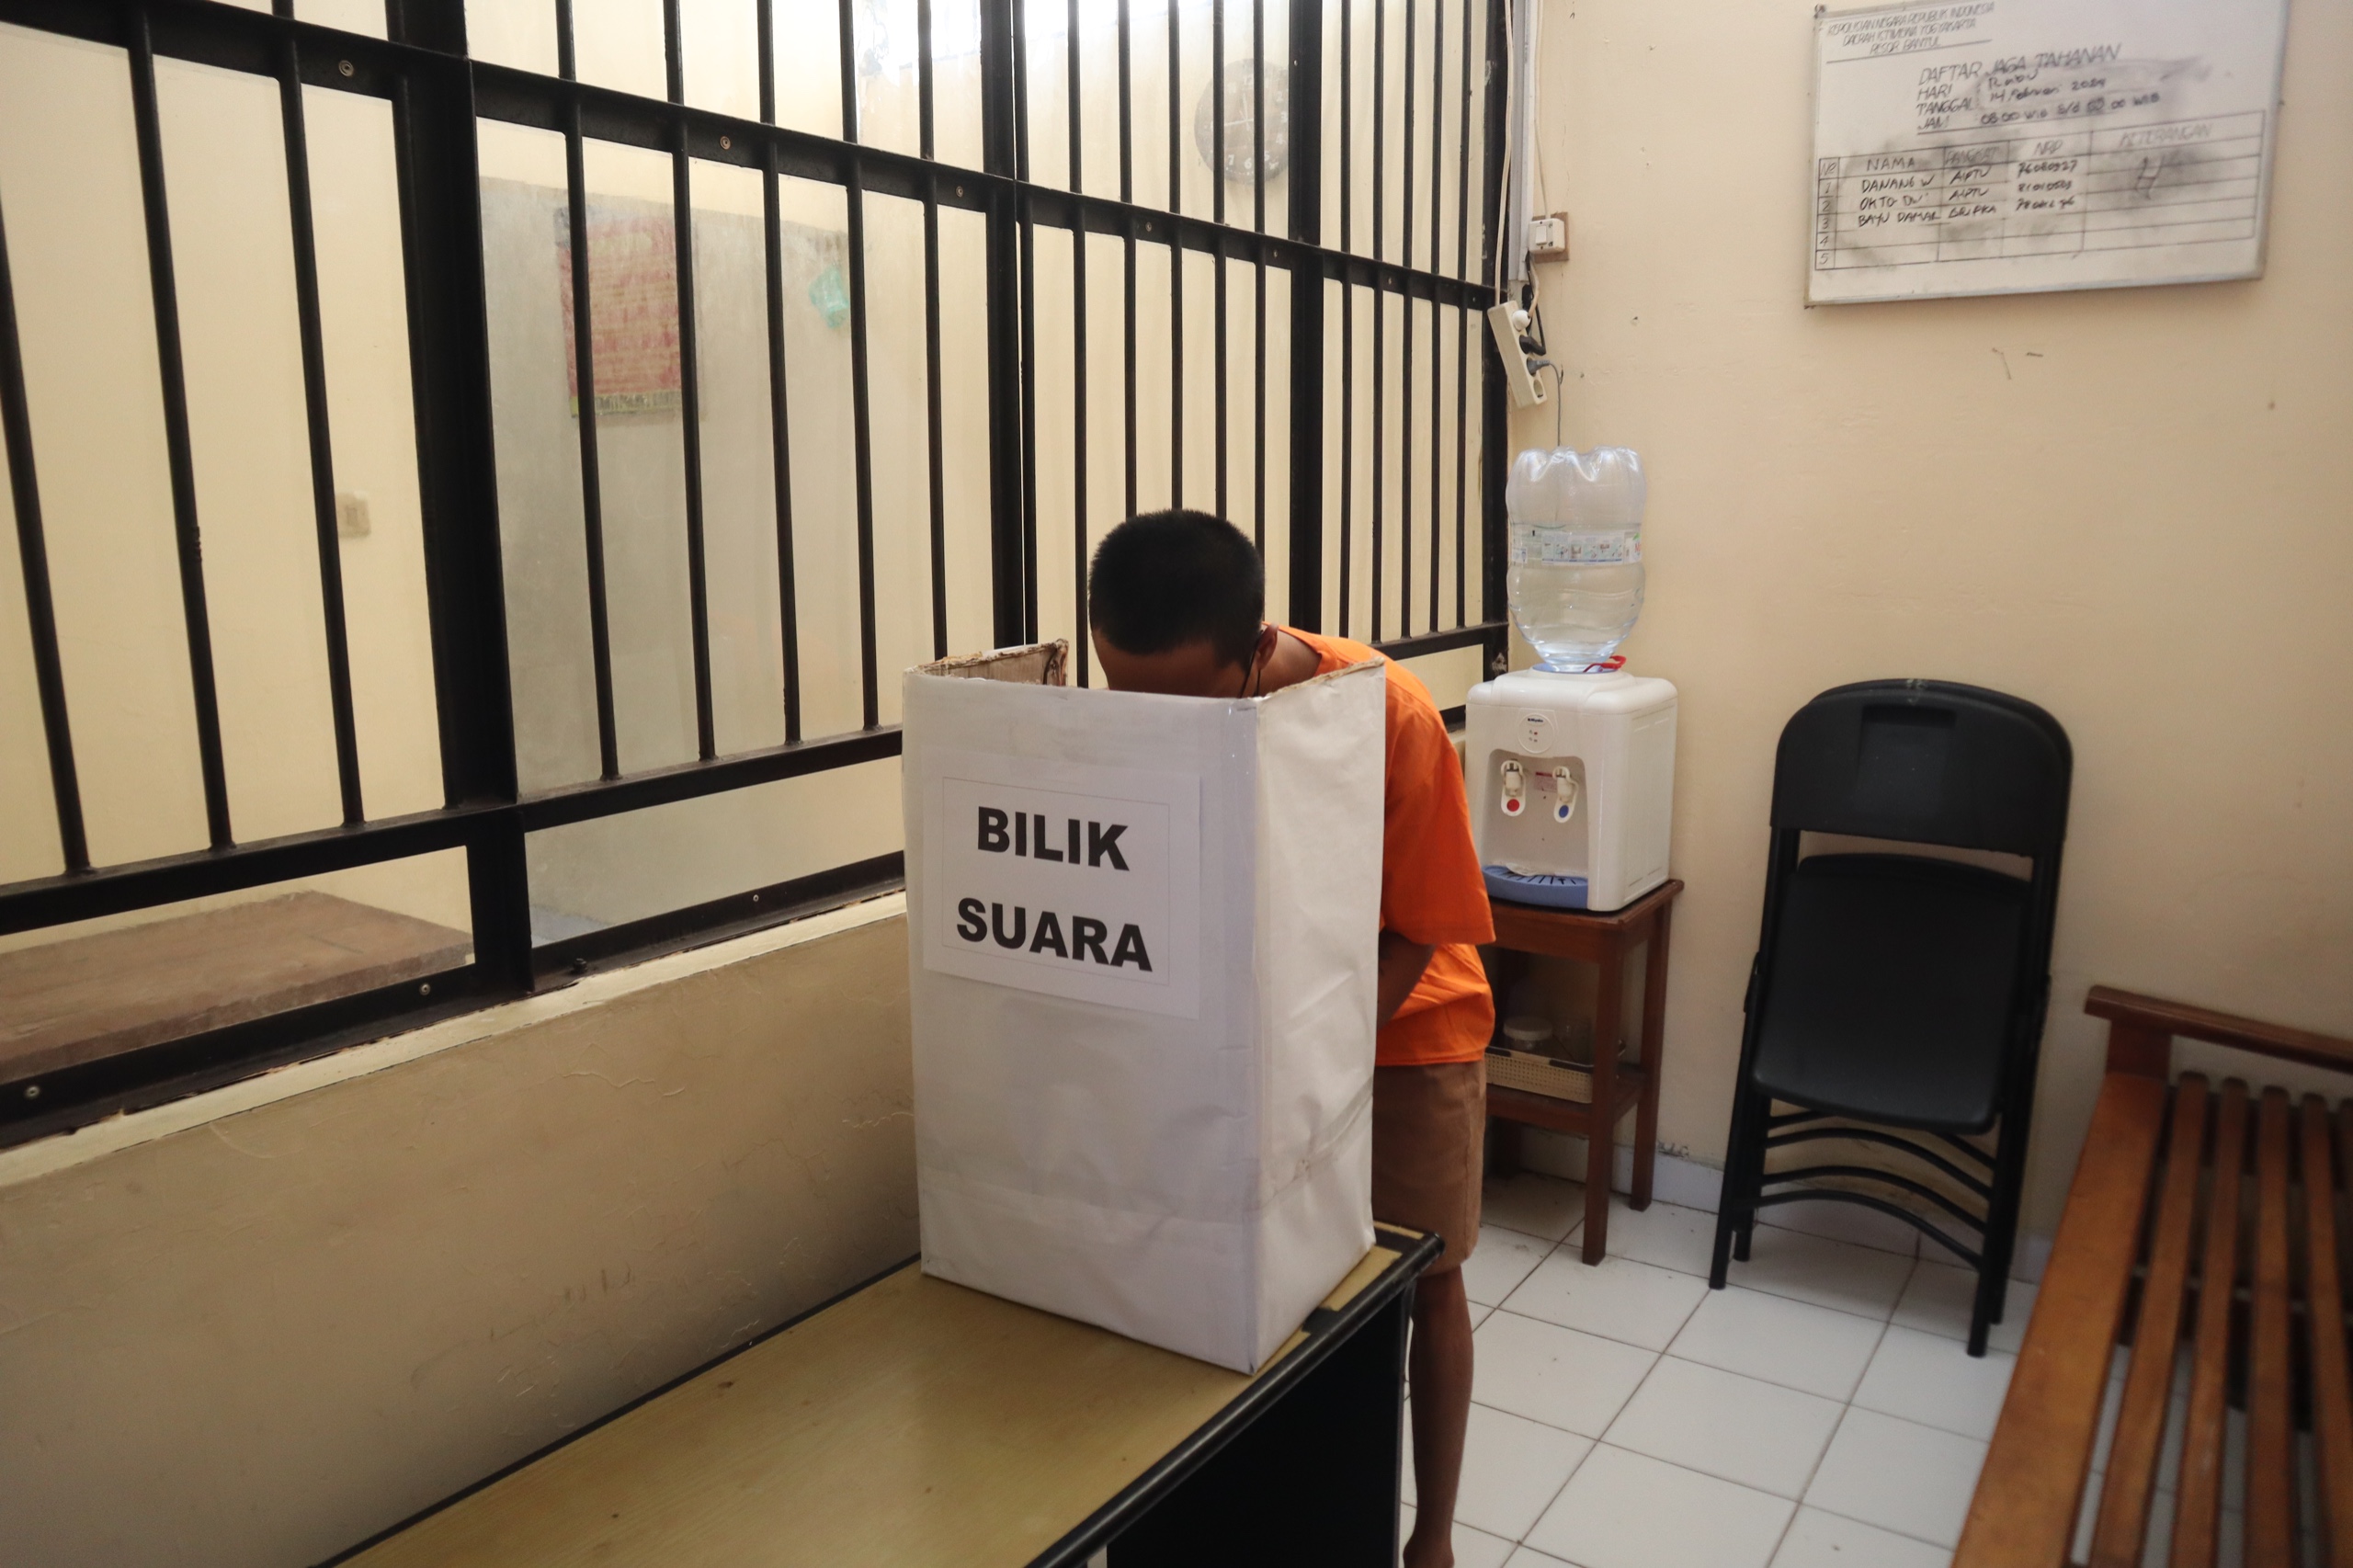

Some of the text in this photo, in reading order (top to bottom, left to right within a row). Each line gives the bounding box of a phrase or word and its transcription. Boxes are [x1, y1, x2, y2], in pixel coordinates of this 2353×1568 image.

[1918, 43, 2122, 85] DAFTAR JAGA TAHANAN
[1916, 84, 1952, 101] HARI
[1915, 97, 1973, 116] TANGGAL
[1227, 153, 1235, 165] 7
[1244, 156, 1253, 169] 6
[1866, 156, 1916, 172] NAMA
[1861, 177, 1915, 194] DANANG
[1949, 165, 1992, 185] AIPTU
[1822, 201, 1831, 213] 2
[1821, 217, 1830, 230] 3
[1858, 211, 1892, 227] BAYU
[1819, 235, 1829, 249] 4
[1819, 252, 1829, 266] 5
[978, 806, 1130, 871] BILIK
[957, 897, 1153, 972] SUARA
